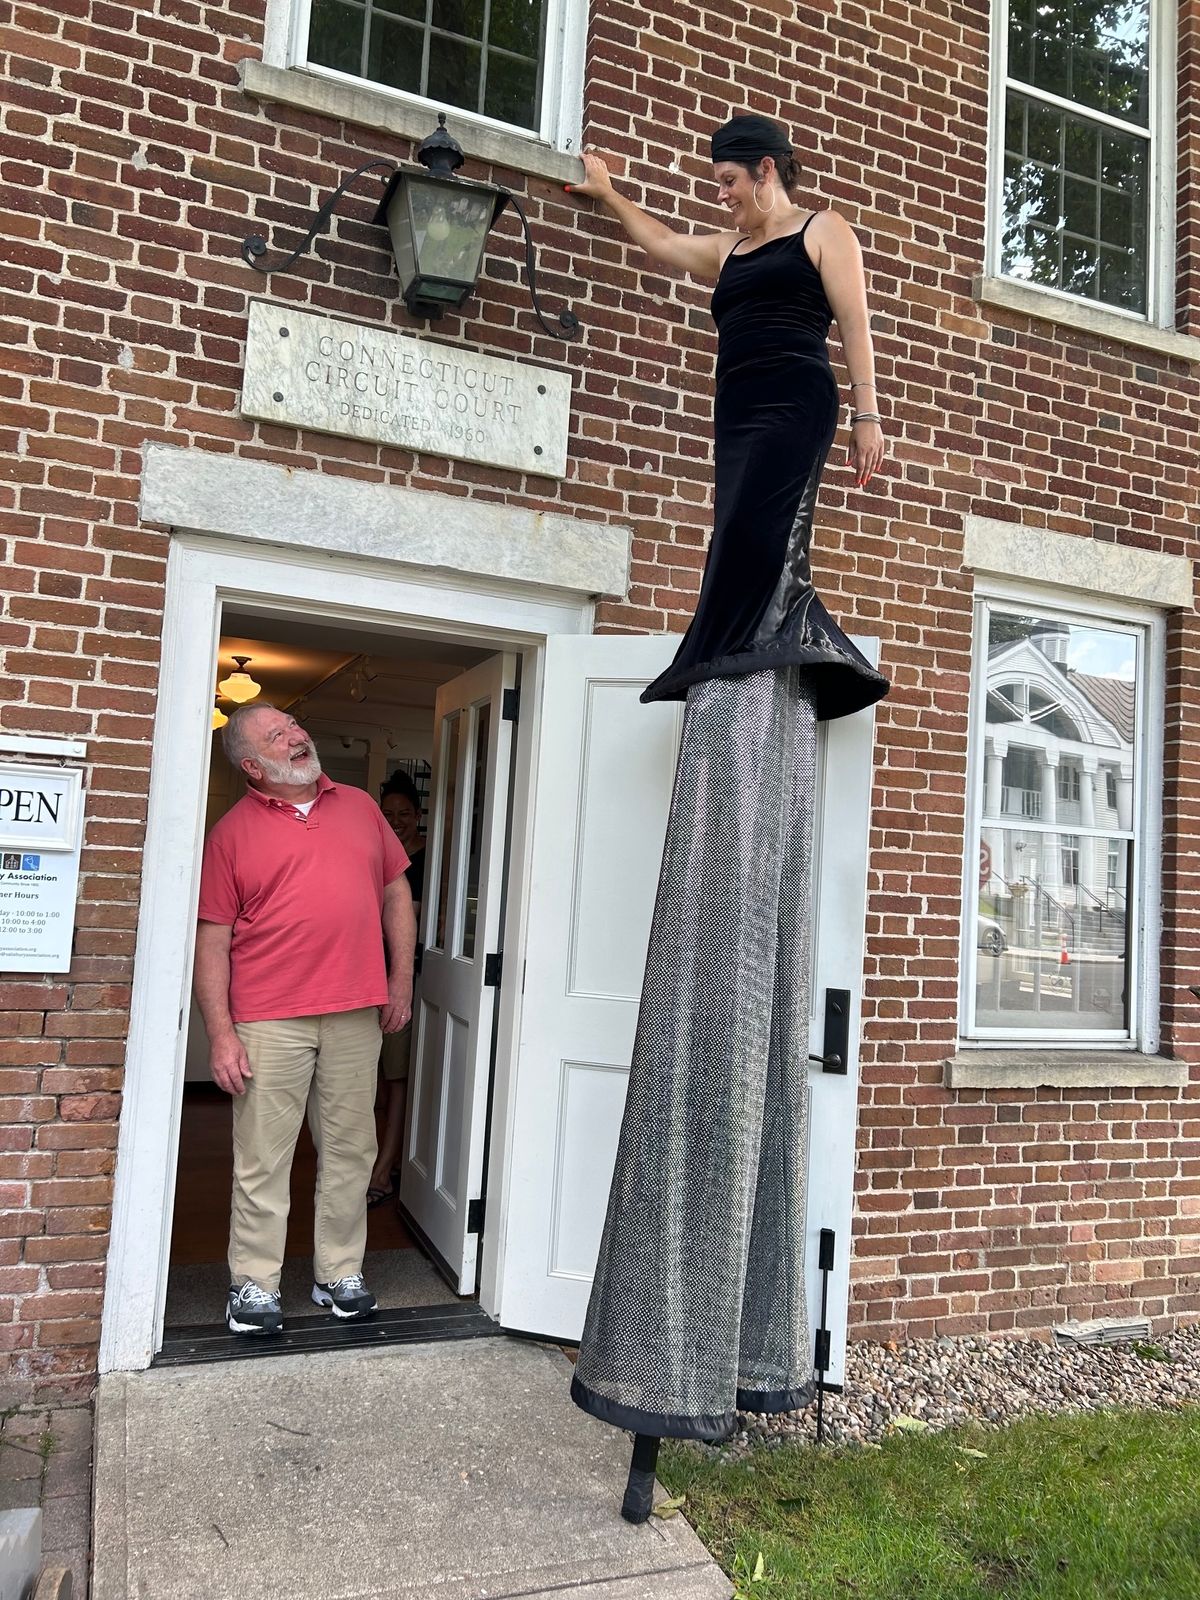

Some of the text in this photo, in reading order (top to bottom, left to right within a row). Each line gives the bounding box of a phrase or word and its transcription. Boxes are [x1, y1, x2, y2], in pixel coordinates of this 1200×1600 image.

[319, 335, 514, 396] CONNECTICUT
[305, 360, 522, 424] CIRCUIT COURT
[340, 401, 485, 443] DEDICATED 1960
[8, 872, 57, 881] Association
[14, 892, 39, 900] Hours
